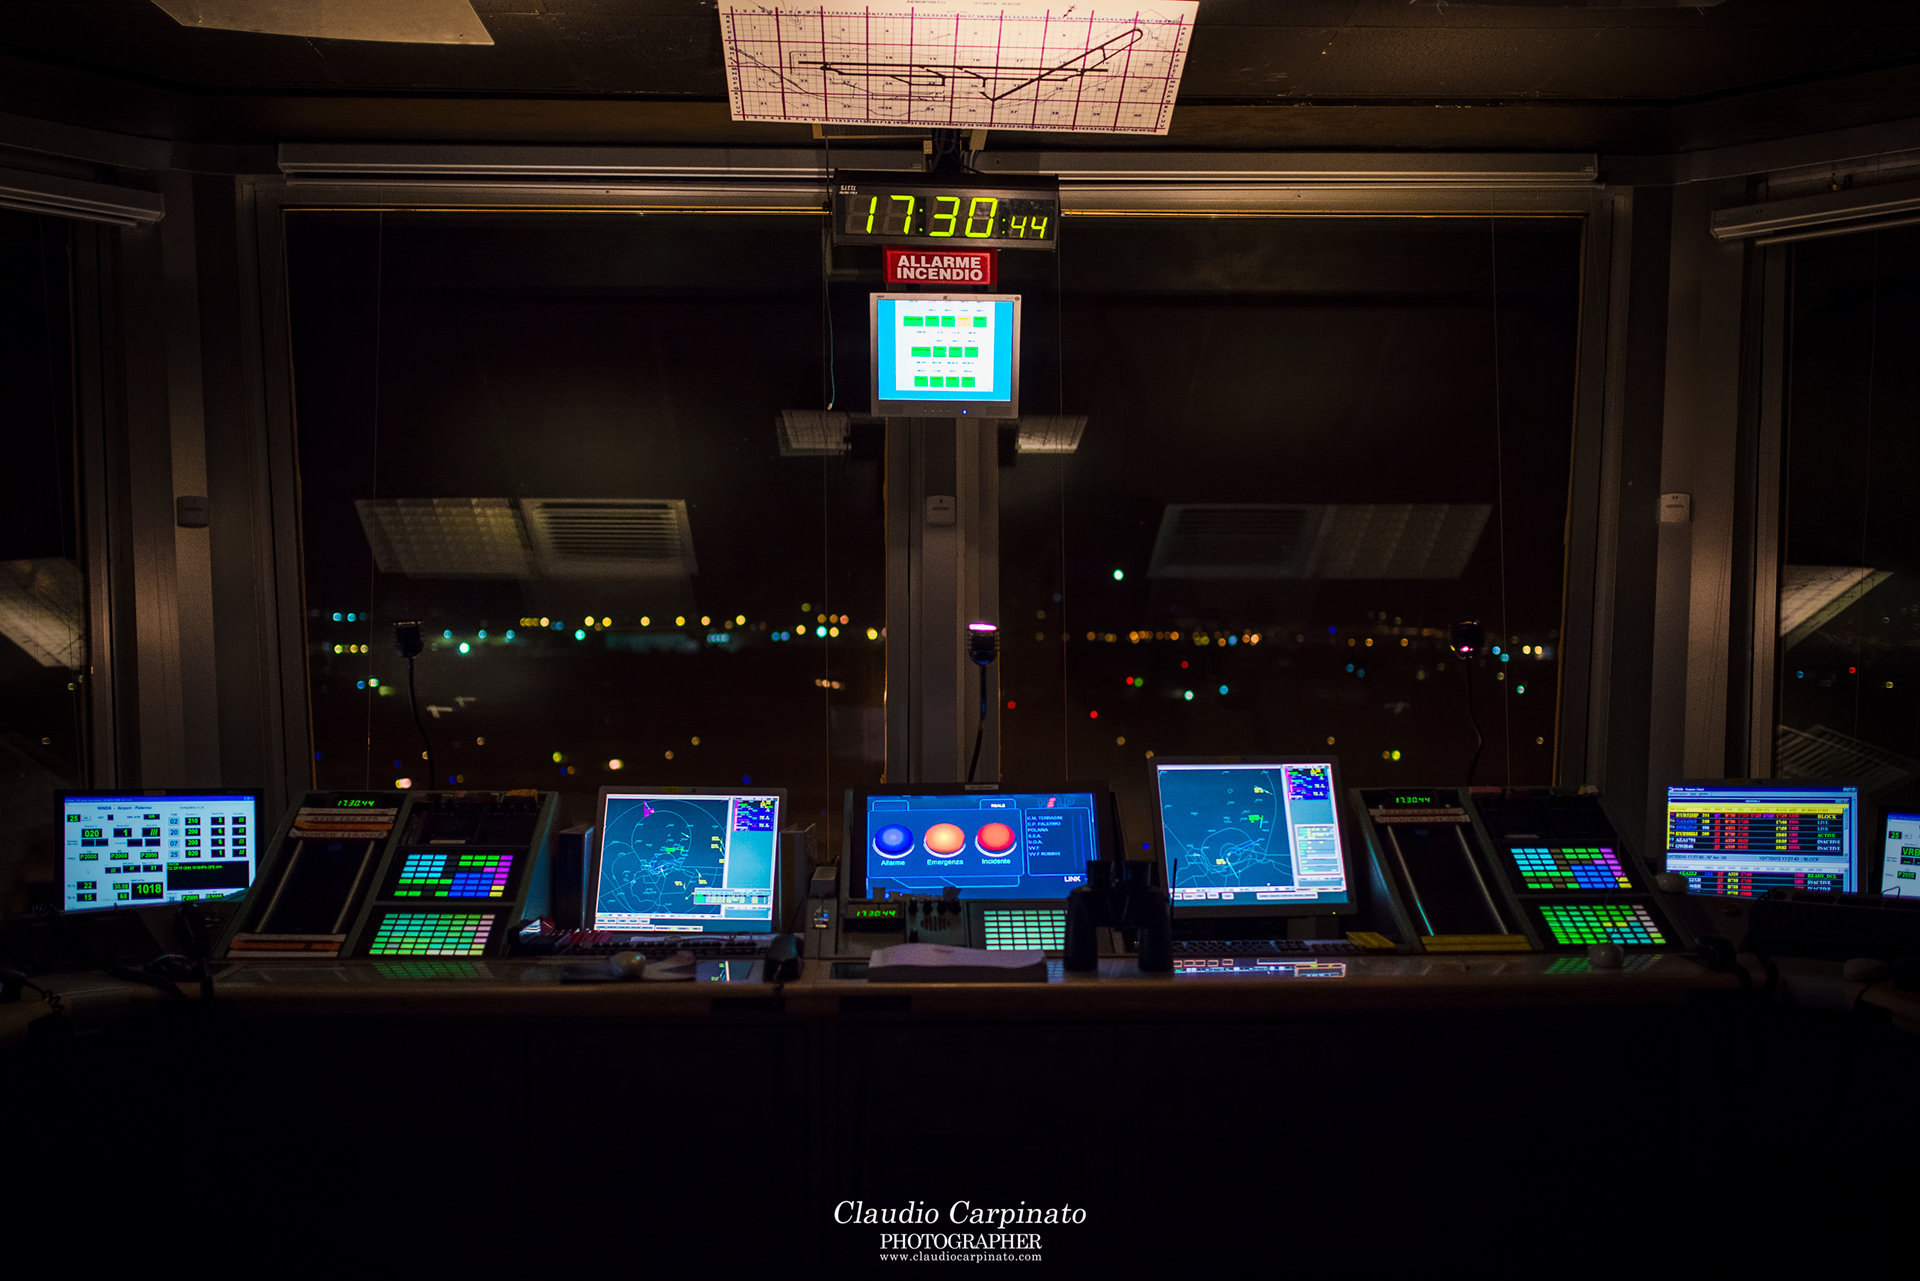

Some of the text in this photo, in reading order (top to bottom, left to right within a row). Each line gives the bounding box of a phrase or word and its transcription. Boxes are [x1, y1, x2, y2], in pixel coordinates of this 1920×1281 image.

[898, 255, 981, 269] ALLARME
[896, 267, 983, 281] INCENDIO
[84, 829, 100, 838] 020
[123, 829, 128, 837] 1
[880, 859, 906, 867] Allarme
[927, 859, 964, 867] Emergenza
[136, 884, 162, 894] 1018
